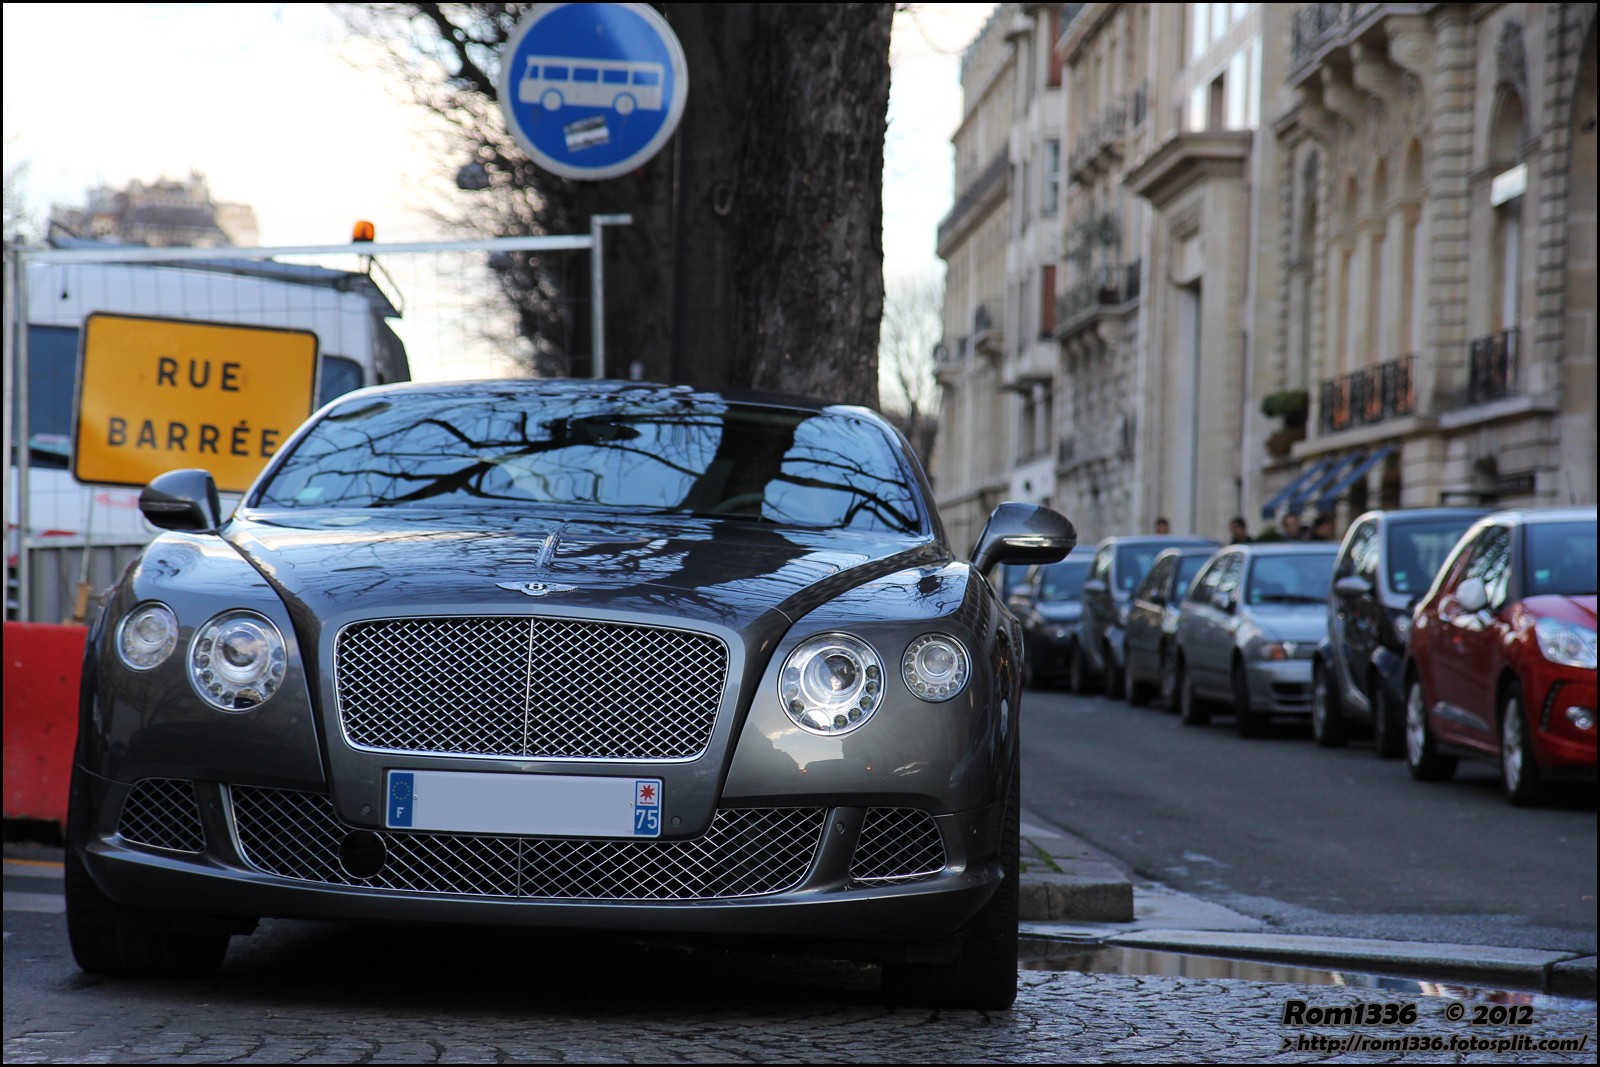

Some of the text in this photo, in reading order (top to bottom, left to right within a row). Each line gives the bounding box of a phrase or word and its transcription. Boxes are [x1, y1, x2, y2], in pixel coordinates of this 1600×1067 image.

[157, 356, 241, 392] RUE
[107, 416, 280, 459] BARRÉE
[396, 806, 405, 819] F
[636, 809, 658, 830] 75
